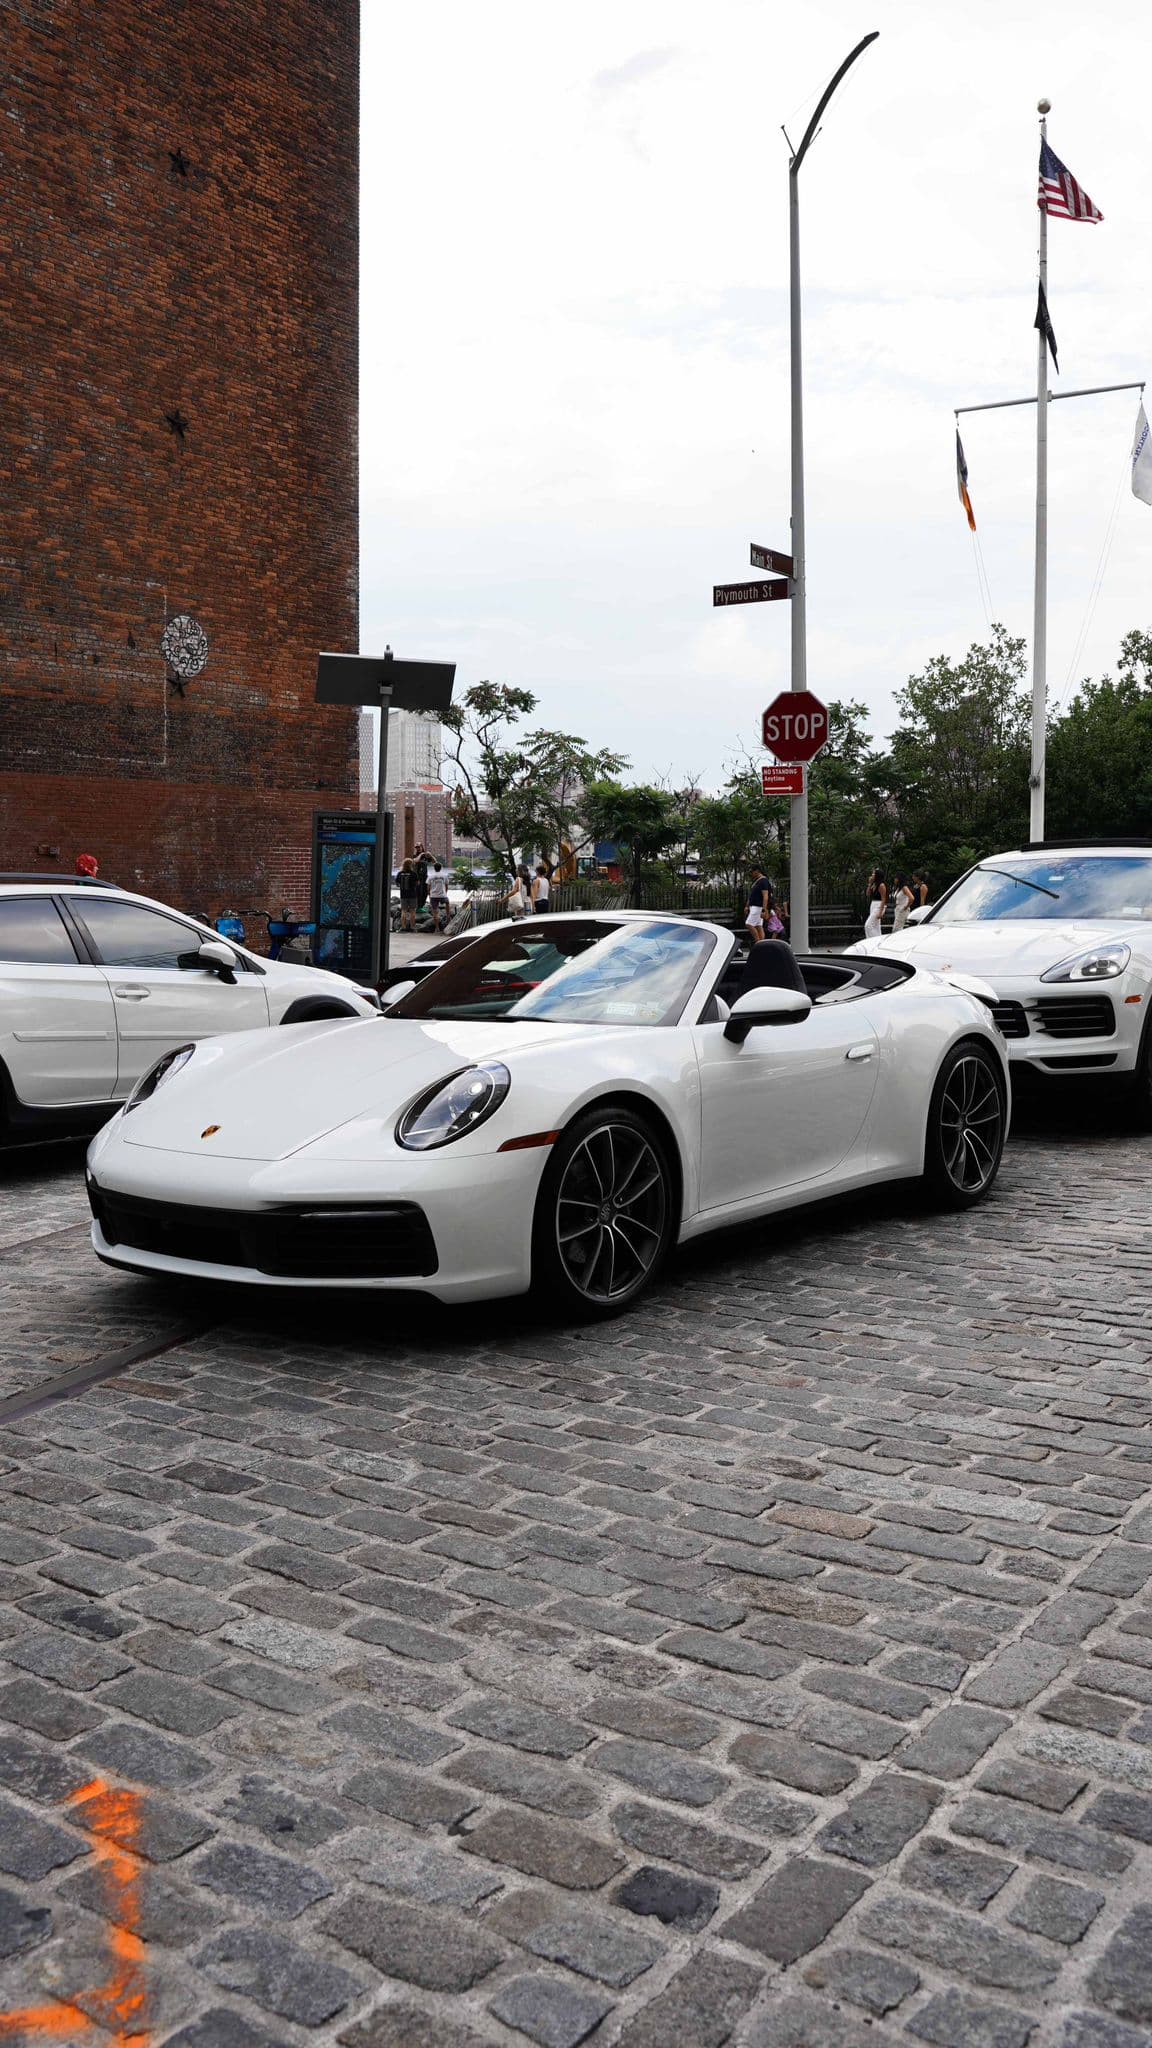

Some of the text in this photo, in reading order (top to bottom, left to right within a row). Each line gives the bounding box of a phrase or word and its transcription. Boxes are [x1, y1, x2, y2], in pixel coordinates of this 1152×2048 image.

[752, 550, 773, 569] Main St
[715, 584, 773, 605] Plymouth St
[766, 713, 825, 741] STOP
